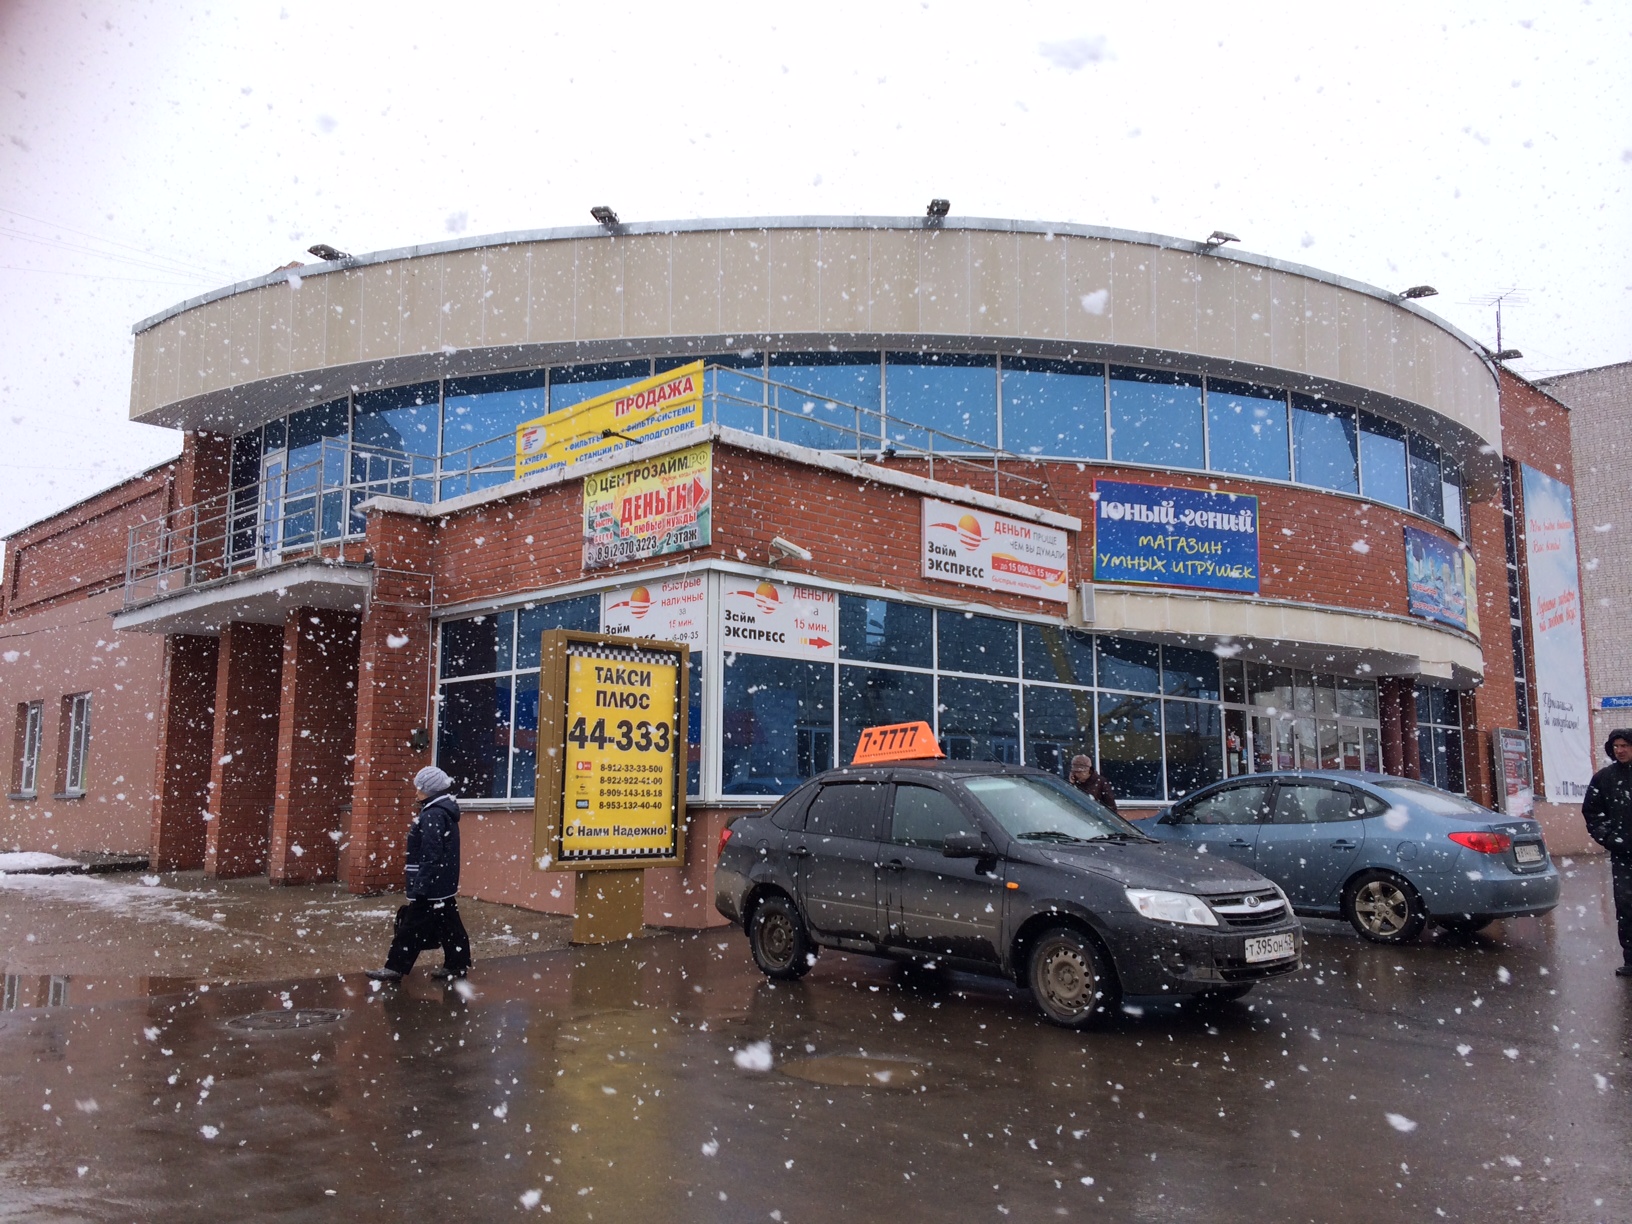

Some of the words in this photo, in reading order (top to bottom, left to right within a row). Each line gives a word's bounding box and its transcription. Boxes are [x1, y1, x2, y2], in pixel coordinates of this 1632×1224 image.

[614, 377, 694, 417] ПРОДАЖА
[620, 483, 688, 528] ДЕНЬГИ
[1101, 500, 1178, 525] Юный
[620, 528, 630, 538] на
[633, 520, 663, 536] любые
[994, 521, 1031, 540] ДЕНЬГИ
[1033, 532, 1057, 546] ПРОЩЕ
[620, 540, 635, 556] 370
[666, 532, 672, 546] 2
[673, 529, 698, 544] этаж
[928, 541, 957, 558] Займ
[1010, 541, 1024, 551] ЧЕМ
[1025, 544, 1035, 554] ВЫ
[1139, 535, 1222, 554] МАГАЗИН
[928, 558, 985, 579] ЭКСПРЕСС
[1009, 562, 1016, 572] 15
[1037, 569, 1045, 578] 15
[1100, 553, 1167, 573] УМНЫХ
[1173, 560, 1256, 579] ИГРУШЕК
[662, 578, 702, 592] быстрые
[661, 592, 704, 607] наличные
[793, 587, 834, 604] ДЕНЬГИ
[679, 608, 687, 616] за
[724, 609, 756, 624] Займ
[605, 624, 631, 635] Займ
[669, 620, 677, 629] 15
[678, 620, 694, 628] мин.
[794, 618, 805, 630] 15
[807, 622, 830, 633] мин.
[724, 625, 785, 644] ЭКСПРЕСС
[595, 666, 651, 687] ТАКСИ
[596, 690, 650, 710] ПЛЮС
[568, 717, 670, 753] 44-333
[600, 763, 663, 774] 8-912-33-33-500
[600, 776, 663, 785] 8-922-922-41-00
[599, 788, 663, 798] 8-909-143-18-18
[599, 801, 662, 810] 8-953-132-40-40
[566, 826, 574, 837] С
[577, 825, 610, 837] Нами
[612, 825, 667, 838] Надежно!
